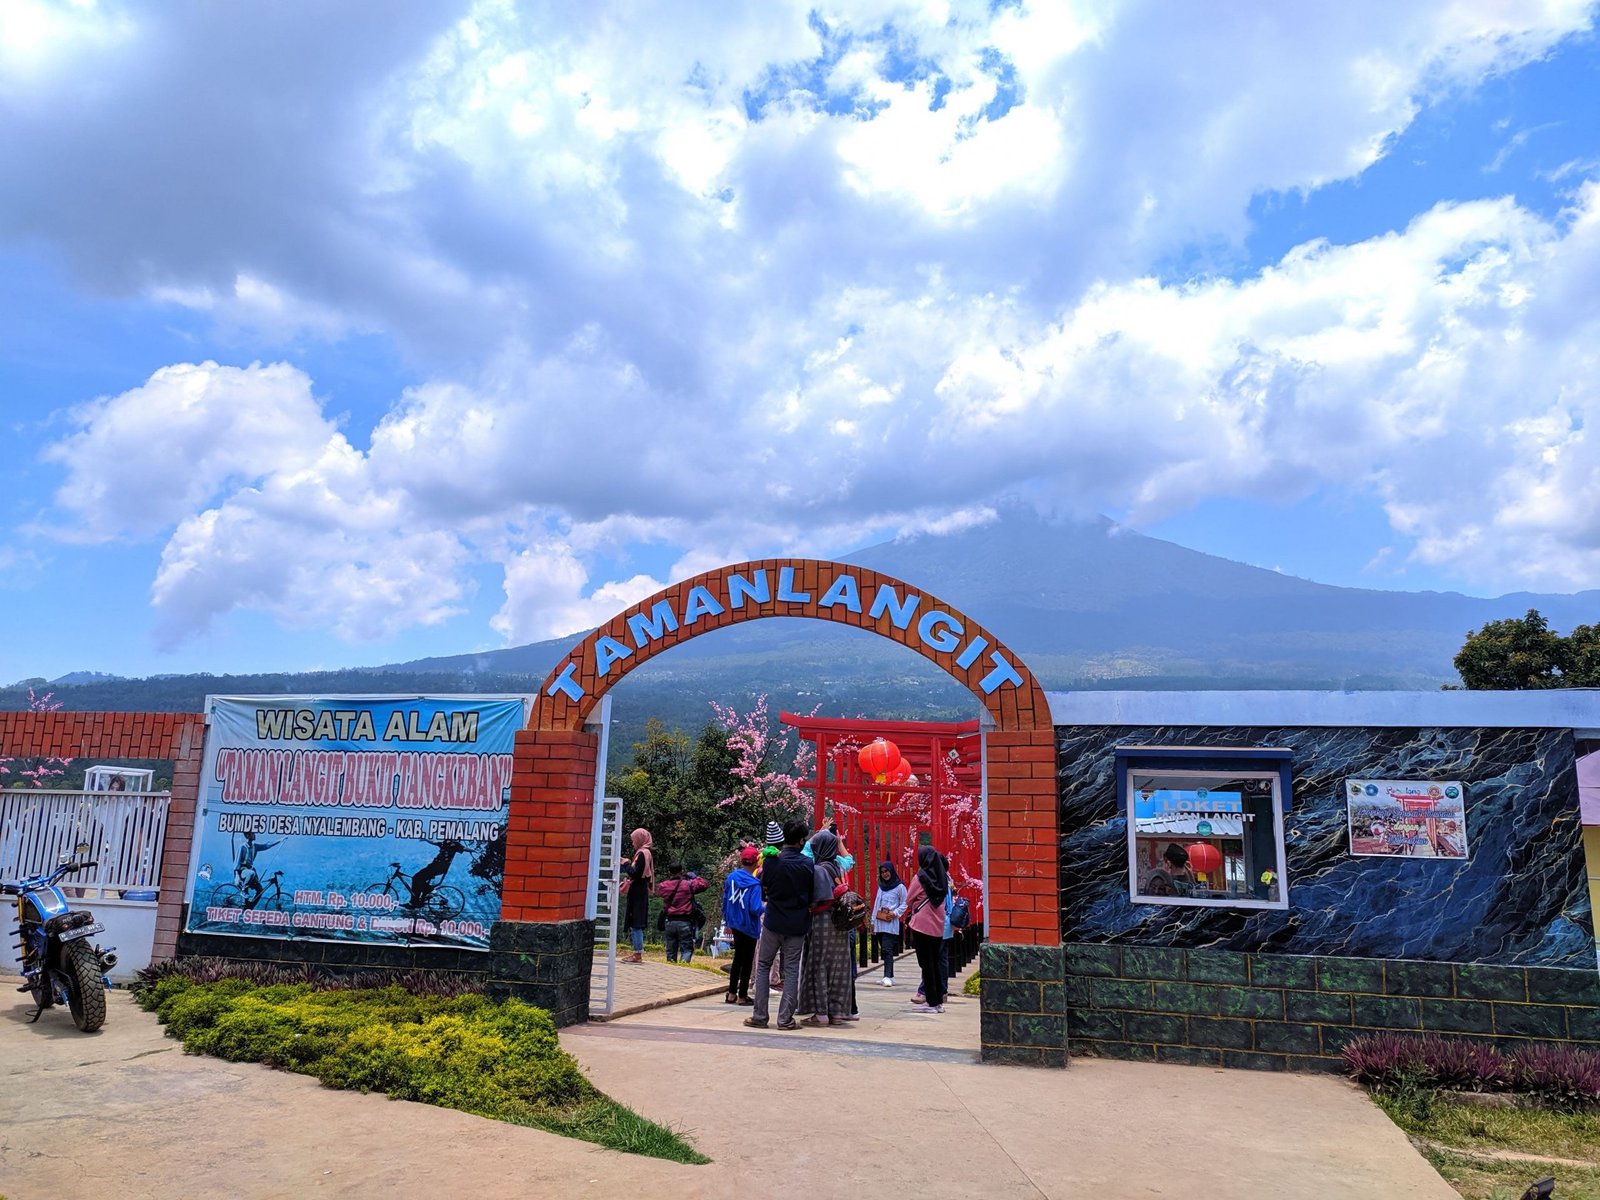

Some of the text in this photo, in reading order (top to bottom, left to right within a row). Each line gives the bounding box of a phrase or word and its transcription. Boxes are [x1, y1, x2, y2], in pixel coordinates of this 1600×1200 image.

[256, 709, 479, 742] WISATA ALAM
[278, 750, 344, 805] LANGIT
[340, 751, 398, 807] BUKIT
[1163, 800, 1242, 812] LOKET
[218, 813, 266, 833] BUMDES
[268, 815, 300, 835] DESA
[302, 817, 386, 838] NYALEMBANG
[395, 819, 427, 839] KAB.
[429, 821, 499, 841] PEMALANG
[294, 890, 399, 911] HTM. Rp. 10.000,-
[206, 907, 241, 923] TIKET
[243, 909, 290, 926] SEPEDA
[292, 912, 354, 930] GANTUNG
[357, 915, 367, 929] &
[415, 918, 438, 936] Rp.
